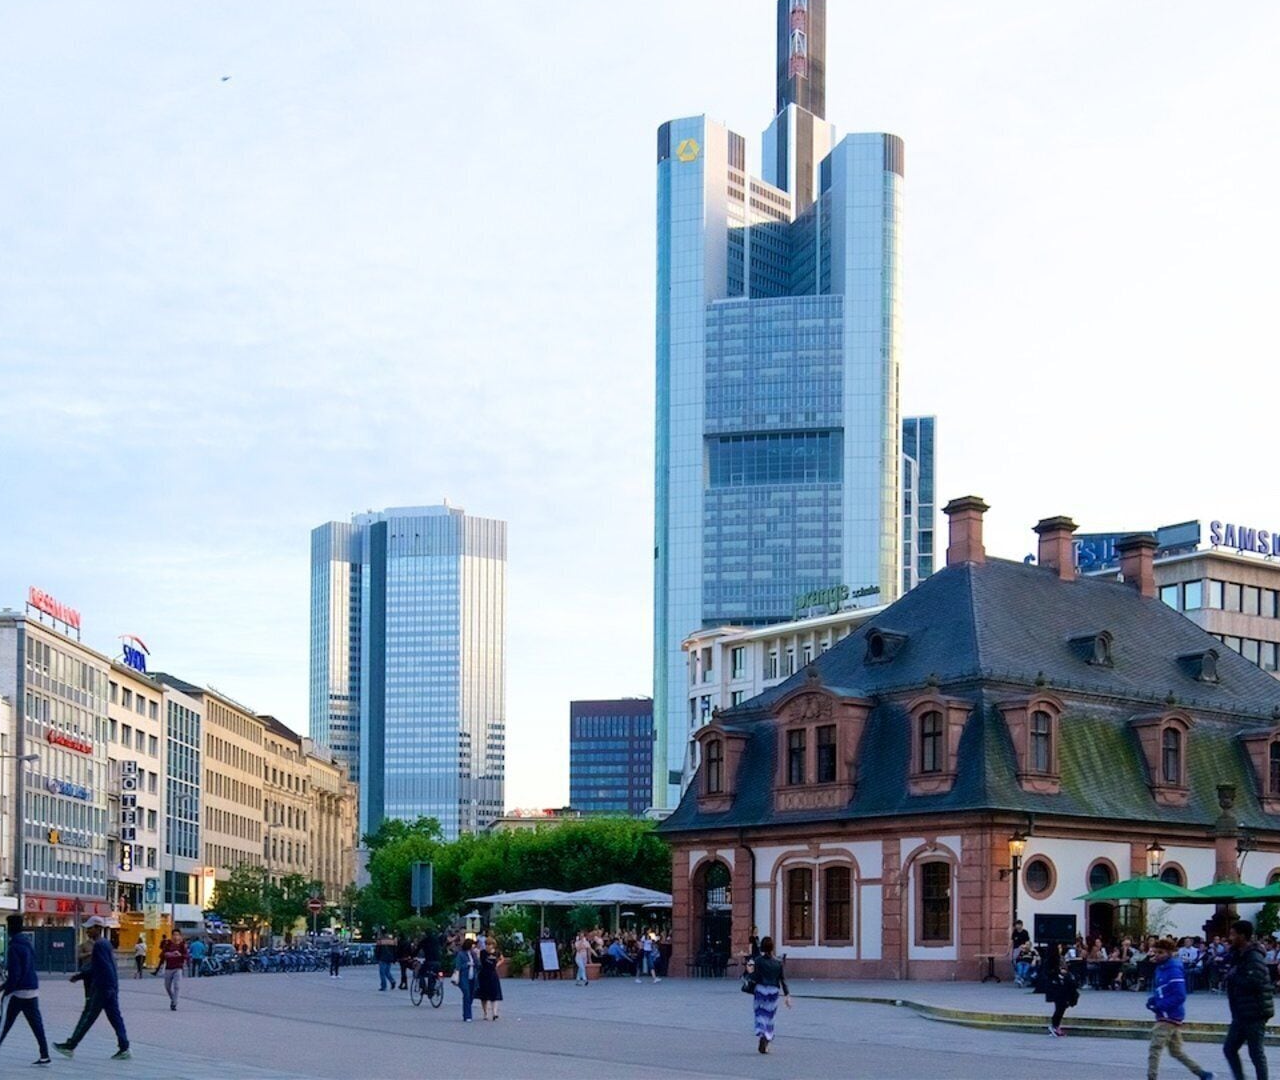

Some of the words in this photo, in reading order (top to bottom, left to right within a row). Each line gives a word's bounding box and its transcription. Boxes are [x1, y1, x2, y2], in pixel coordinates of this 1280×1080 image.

[793, 585, 849, 621] prange
[123, 761, 136, 840] HOTEL
[123, 845, 131, 870] KINO
